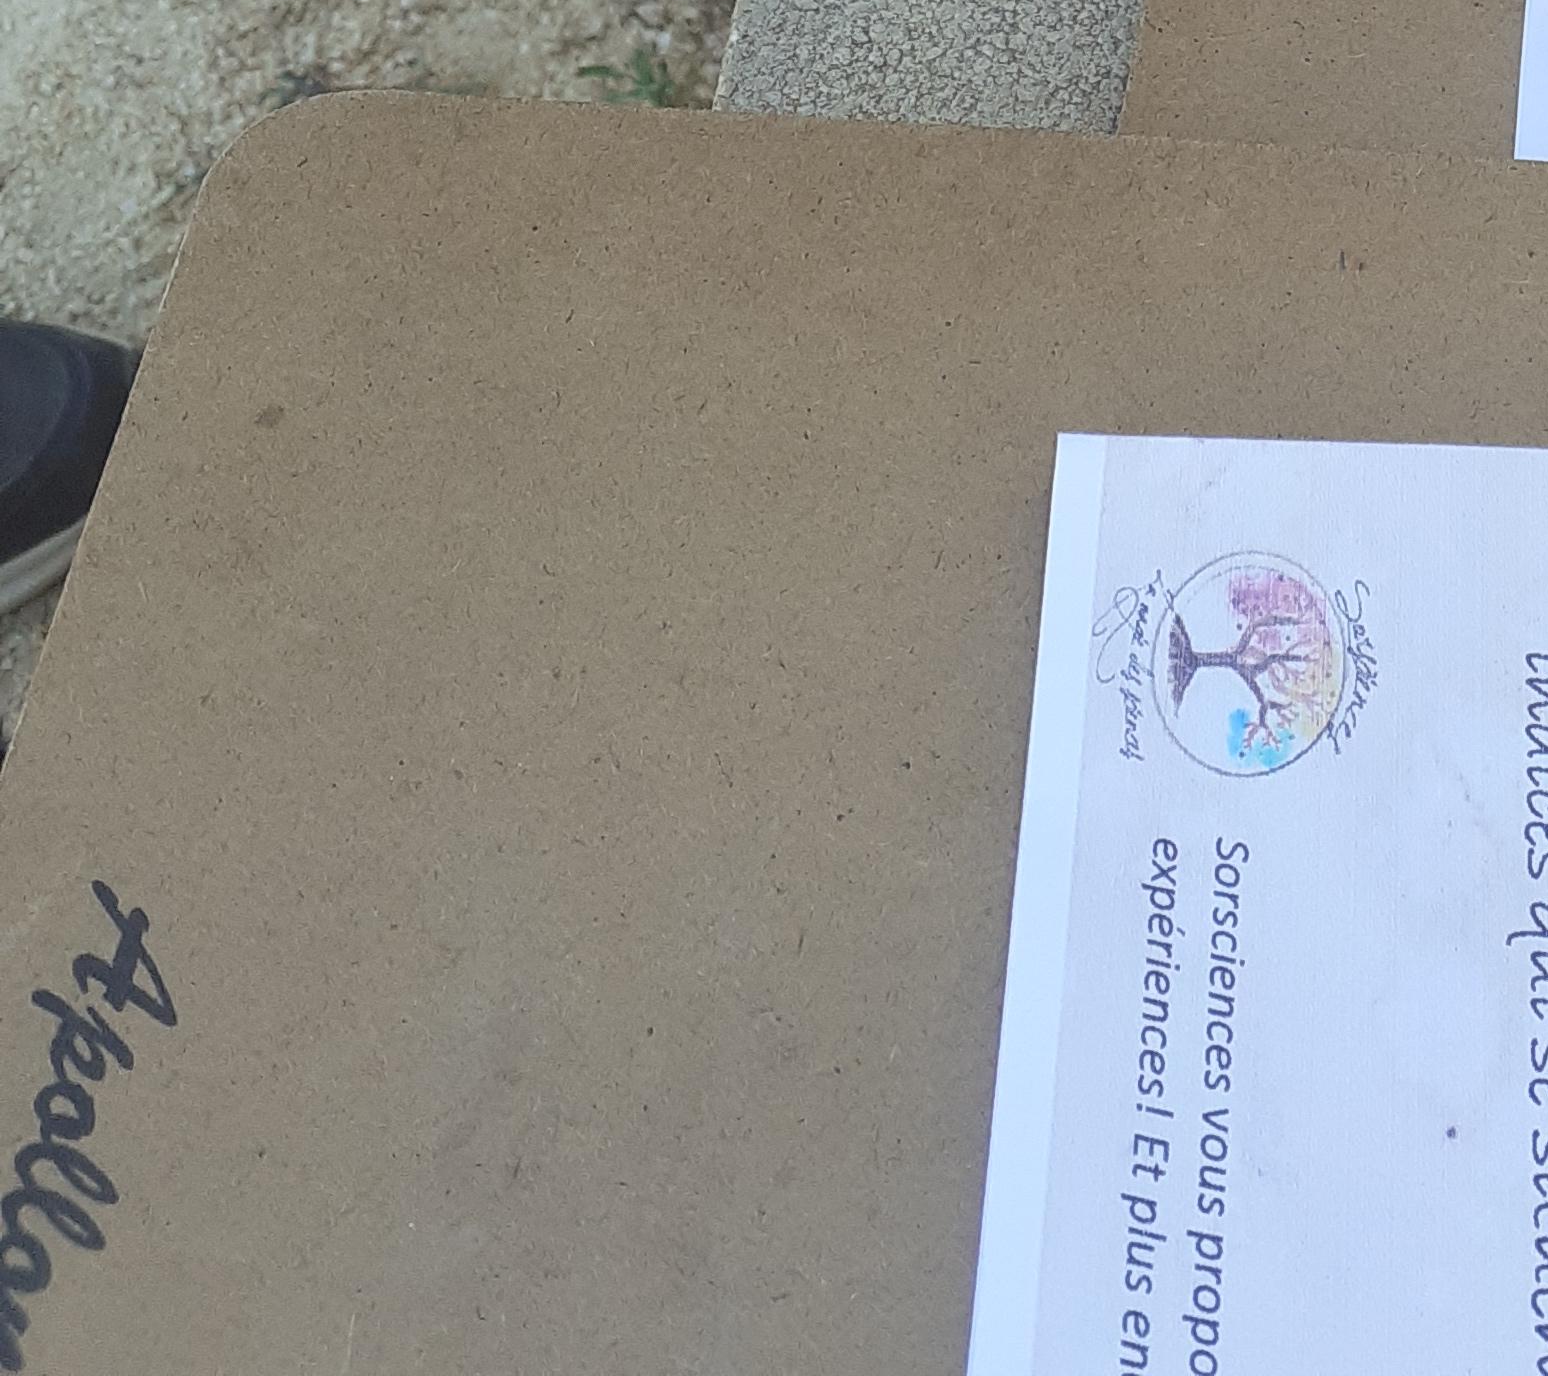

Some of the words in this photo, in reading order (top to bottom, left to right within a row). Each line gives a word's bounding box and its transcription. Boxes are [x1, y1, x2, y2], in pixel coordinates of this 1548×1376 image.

[1129, 836, 1178, 1122] expériences!
[1199, 836, 1249, 1090] Sorsciences
[1131, 1136, 1171, 1178] Et
[1192, 1109, 1229, 1213] vous
[1119, 1192, 1168, 1296] plus
[1119, 1308, 1151, 1376] en
